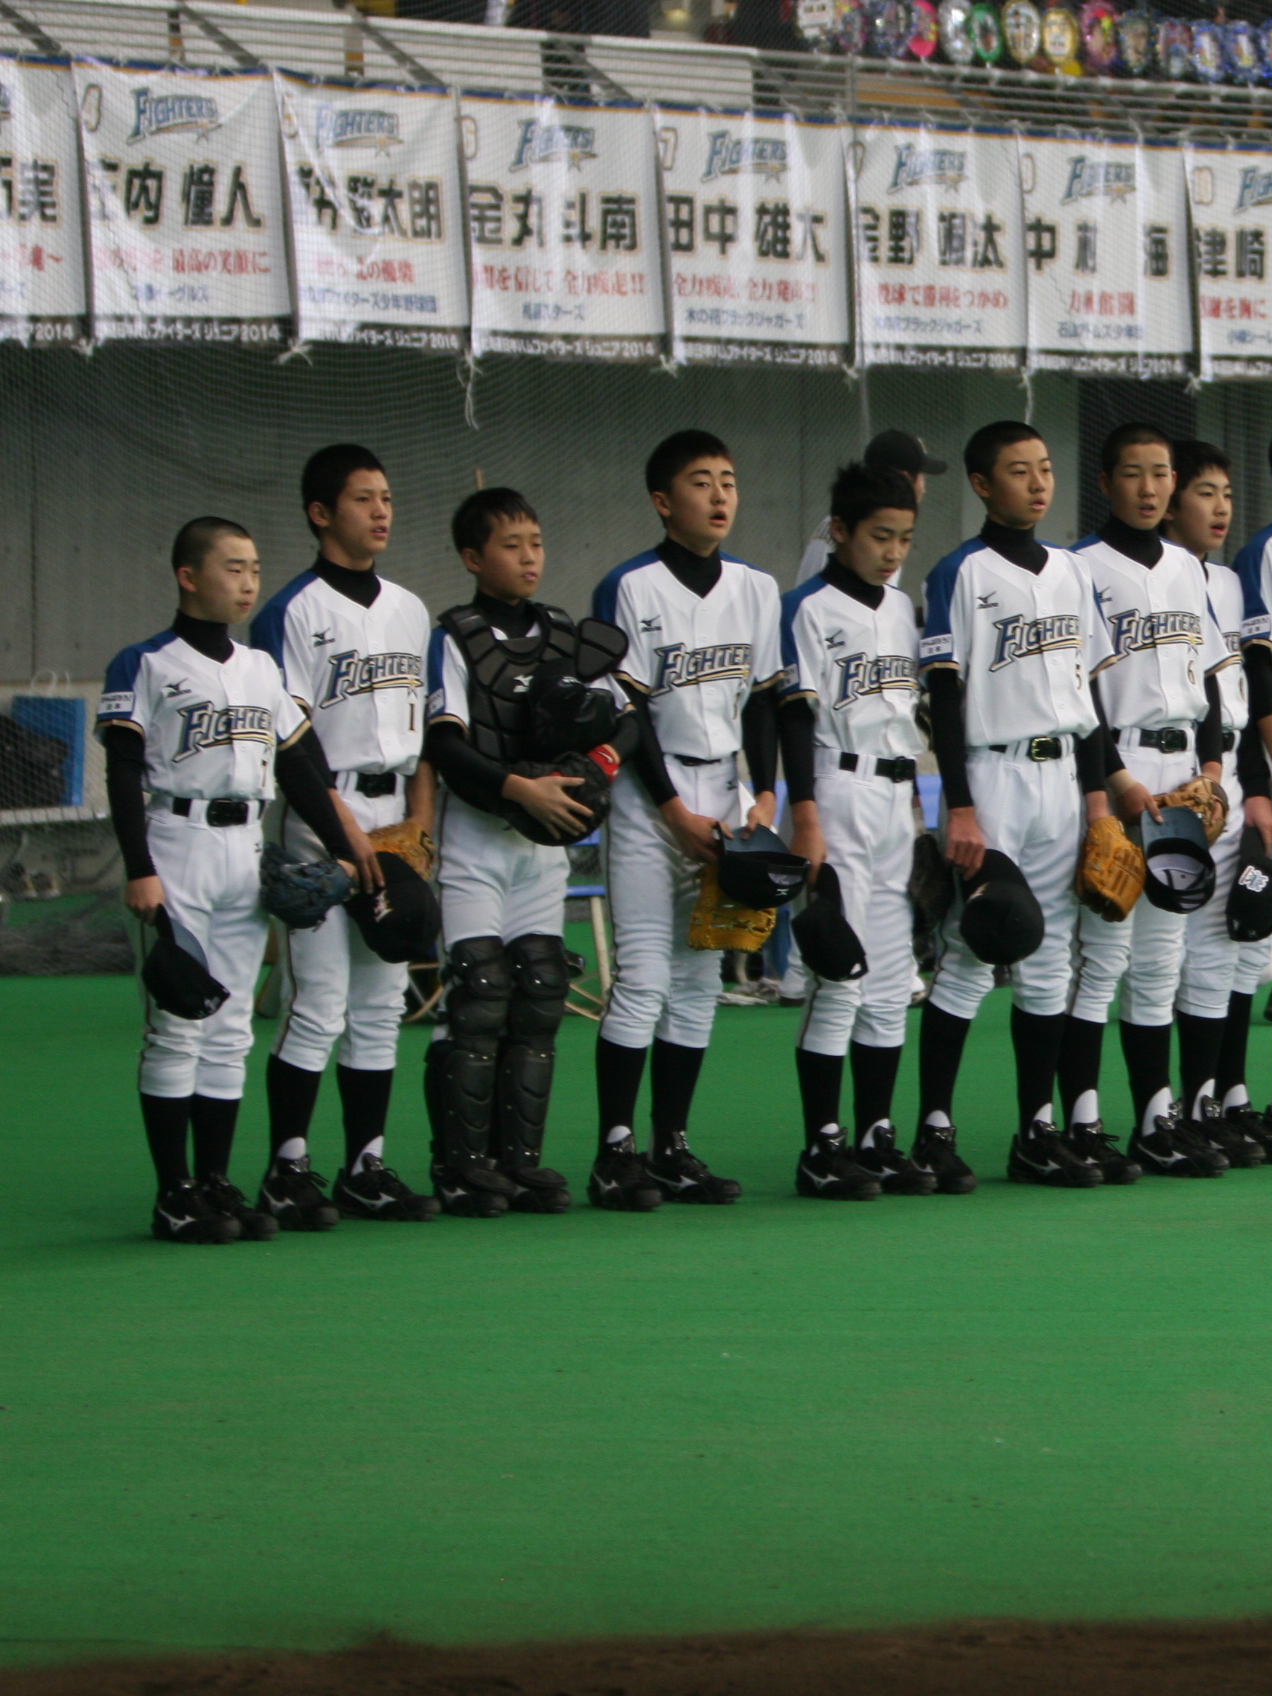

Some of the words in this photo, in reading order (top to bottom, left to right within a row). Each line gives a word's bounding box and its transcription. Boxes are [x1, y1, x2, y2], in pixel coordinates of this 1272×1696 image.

[127, 87, 220, 146] FIGHTERS
[469, 184, 545, 249] 金丸
[561, 188, 638, 252] 斗南
[666, 194, 739, 256] 田中
[755, 201, 826, 264] 雄大
[990, 614, 1080, 672] FIGHTE
[1186, 659, 1197, 686] 6
[320, 649, 424, 709] FIGHTERS
[832, 652, 920, 711] FIGHTE
[172, 700, 273, 763] FIGHTE
[407, 702, 417, 733] 1
